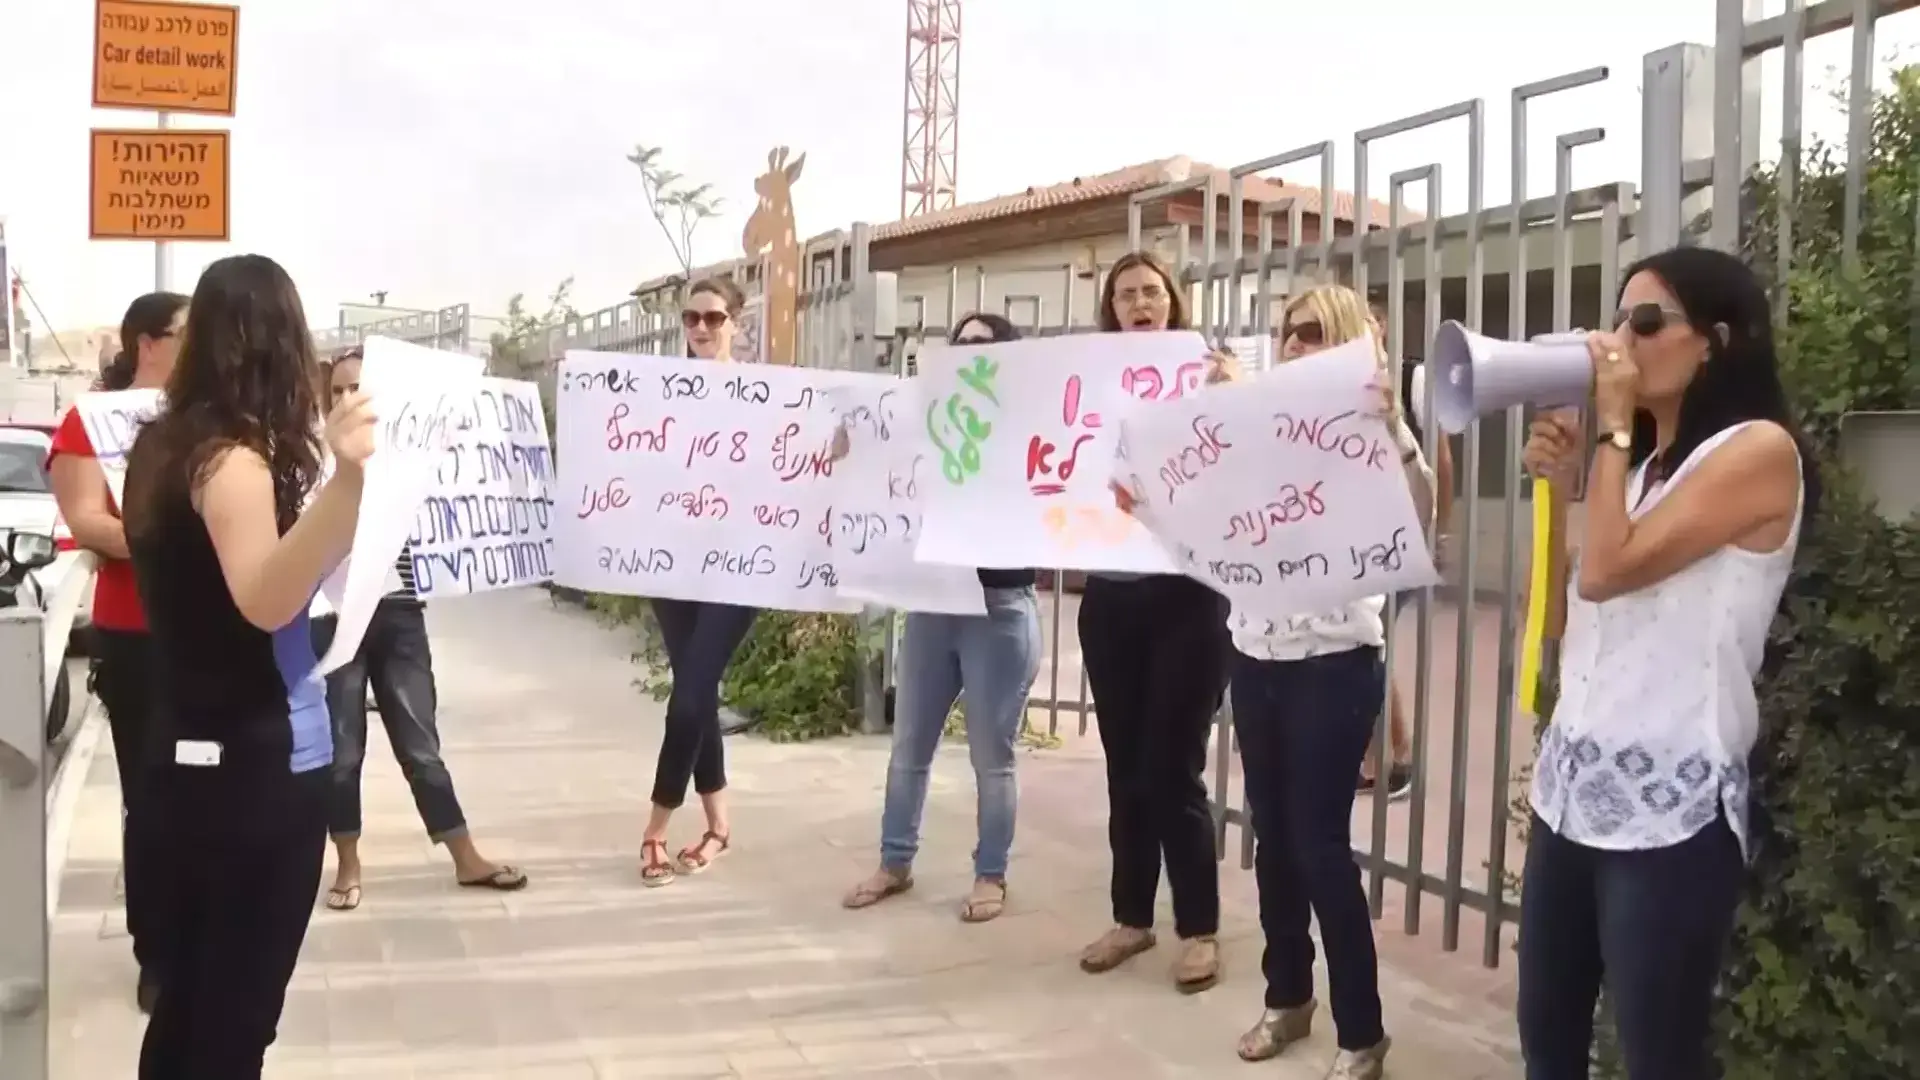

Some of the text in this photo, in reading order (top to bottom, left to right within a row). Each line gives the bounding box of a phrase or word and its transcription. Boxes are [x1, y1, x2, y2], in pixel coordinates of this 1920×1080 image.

[102, 13, 229, 36] פרט לרכב עבודה
[102, 41, 226, 69] Car detail work
[112, 139, 208, 163] זהירות!
[119, 168, 200, 186] משאיות
[108, 189, 210, 209] משתלבות
[132, 213, 185, 233] מימין
[661, 372, 711, 401] שבע
[725, 377, 770, 404] באר
[686, 431, 721, 469] טון
[730, 431, 748, 463] 8
[1273, 409, 1388, 472] אסטמה
[1027, 434, 1095, 482] לא
[888, 453, 924, 500] לא
